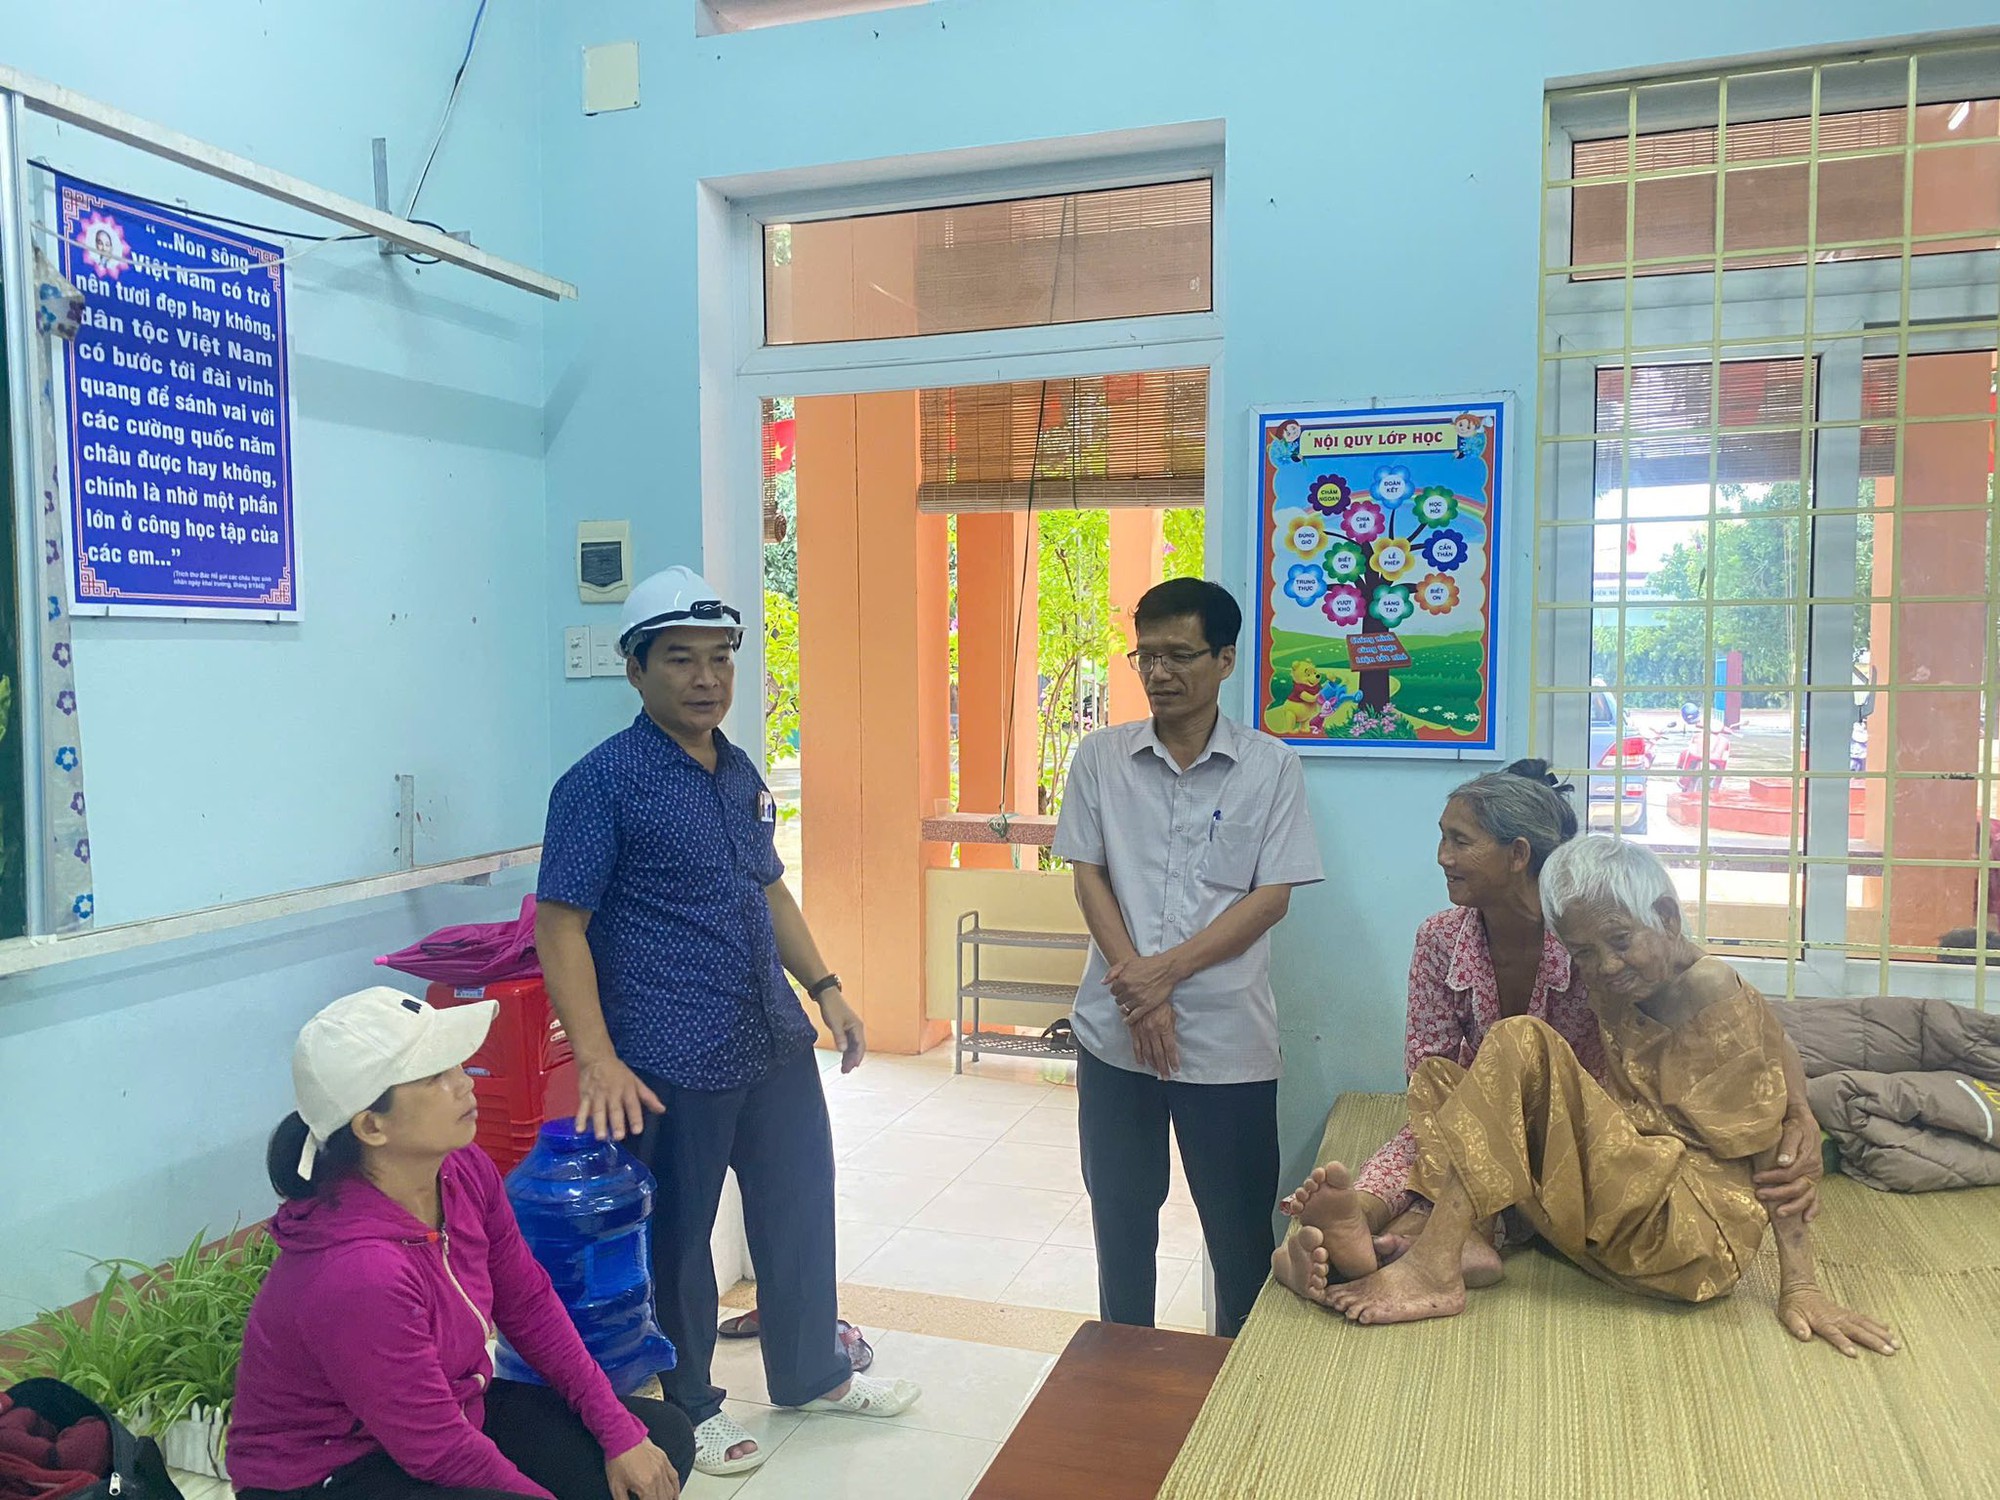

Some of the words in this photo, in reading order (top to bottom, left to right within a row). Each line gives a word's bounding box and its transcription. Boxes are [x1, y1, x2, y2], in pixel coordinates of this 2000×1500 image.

[131, 252, 170, 282] Việt
[176, 264, 216, 294] Nam
[221, 281, 241, 301] có
[247, 286, 271, 308] trở
[211, 247, 249, 275] sông
[76, 274, 110, 297] nên
[116, 281, 150, 308] tươi
[156, 293, 187, 319] đẹp
[192, 305, 220, 328] hay
[225, 309, 276, 342] không,
[81, 306, 124, 334] dân
[132, 318, 169, 345] tộc
[176, 328, 221, 357] Việt
[228, 341, 273, 368] Nam
[79, 342, 105, 363] có
[113, 346, 163, 375] bước
[170, 359, 196, 381] tới
[202, 366, 231, 389] đài
[237, 376, 274, 397] vinh
[80, 377, 141, 406] quang
[147, 385, 170, 408] để
[175, 393, 217, 416] sánh
[222, 404, 246, 422] vai
[251, 409, 275, 427] với
[82, 409, 119, 431] các
[126, 418, 185, 445] cường
[191, 428, 234, 449] quốc
[240, 436, 275, 456] năm
[1314, 434, 1338, 451] NỘI
[1344, 435, 1373, 448] QUY
[1378, 431, 1407, 445] LỚP
[1412, 432, 1443, 446] HỌC
[83, 443, 131, 466] châu
[137, 449, 181, 475] được
[187, 456, 217, 481] hay
[222, 461, 276, 488] không,
[85, 476, 138, 499] chính
[144, 482, 160, 502] là
[166, 486, 198, 506] nhờ
[203, 492, 234, 513] một
[239, 493, 278, 515] phần
[86, 508, 115, 529] lớn
[121, 510, 132, 530] ở
[138, 514, 180, 540] công
[185, 518, 215, 541] học
[220, 522, 246, 545] tập
[251, 524, 279, 544] của
[88, 543, 122, 563] các
